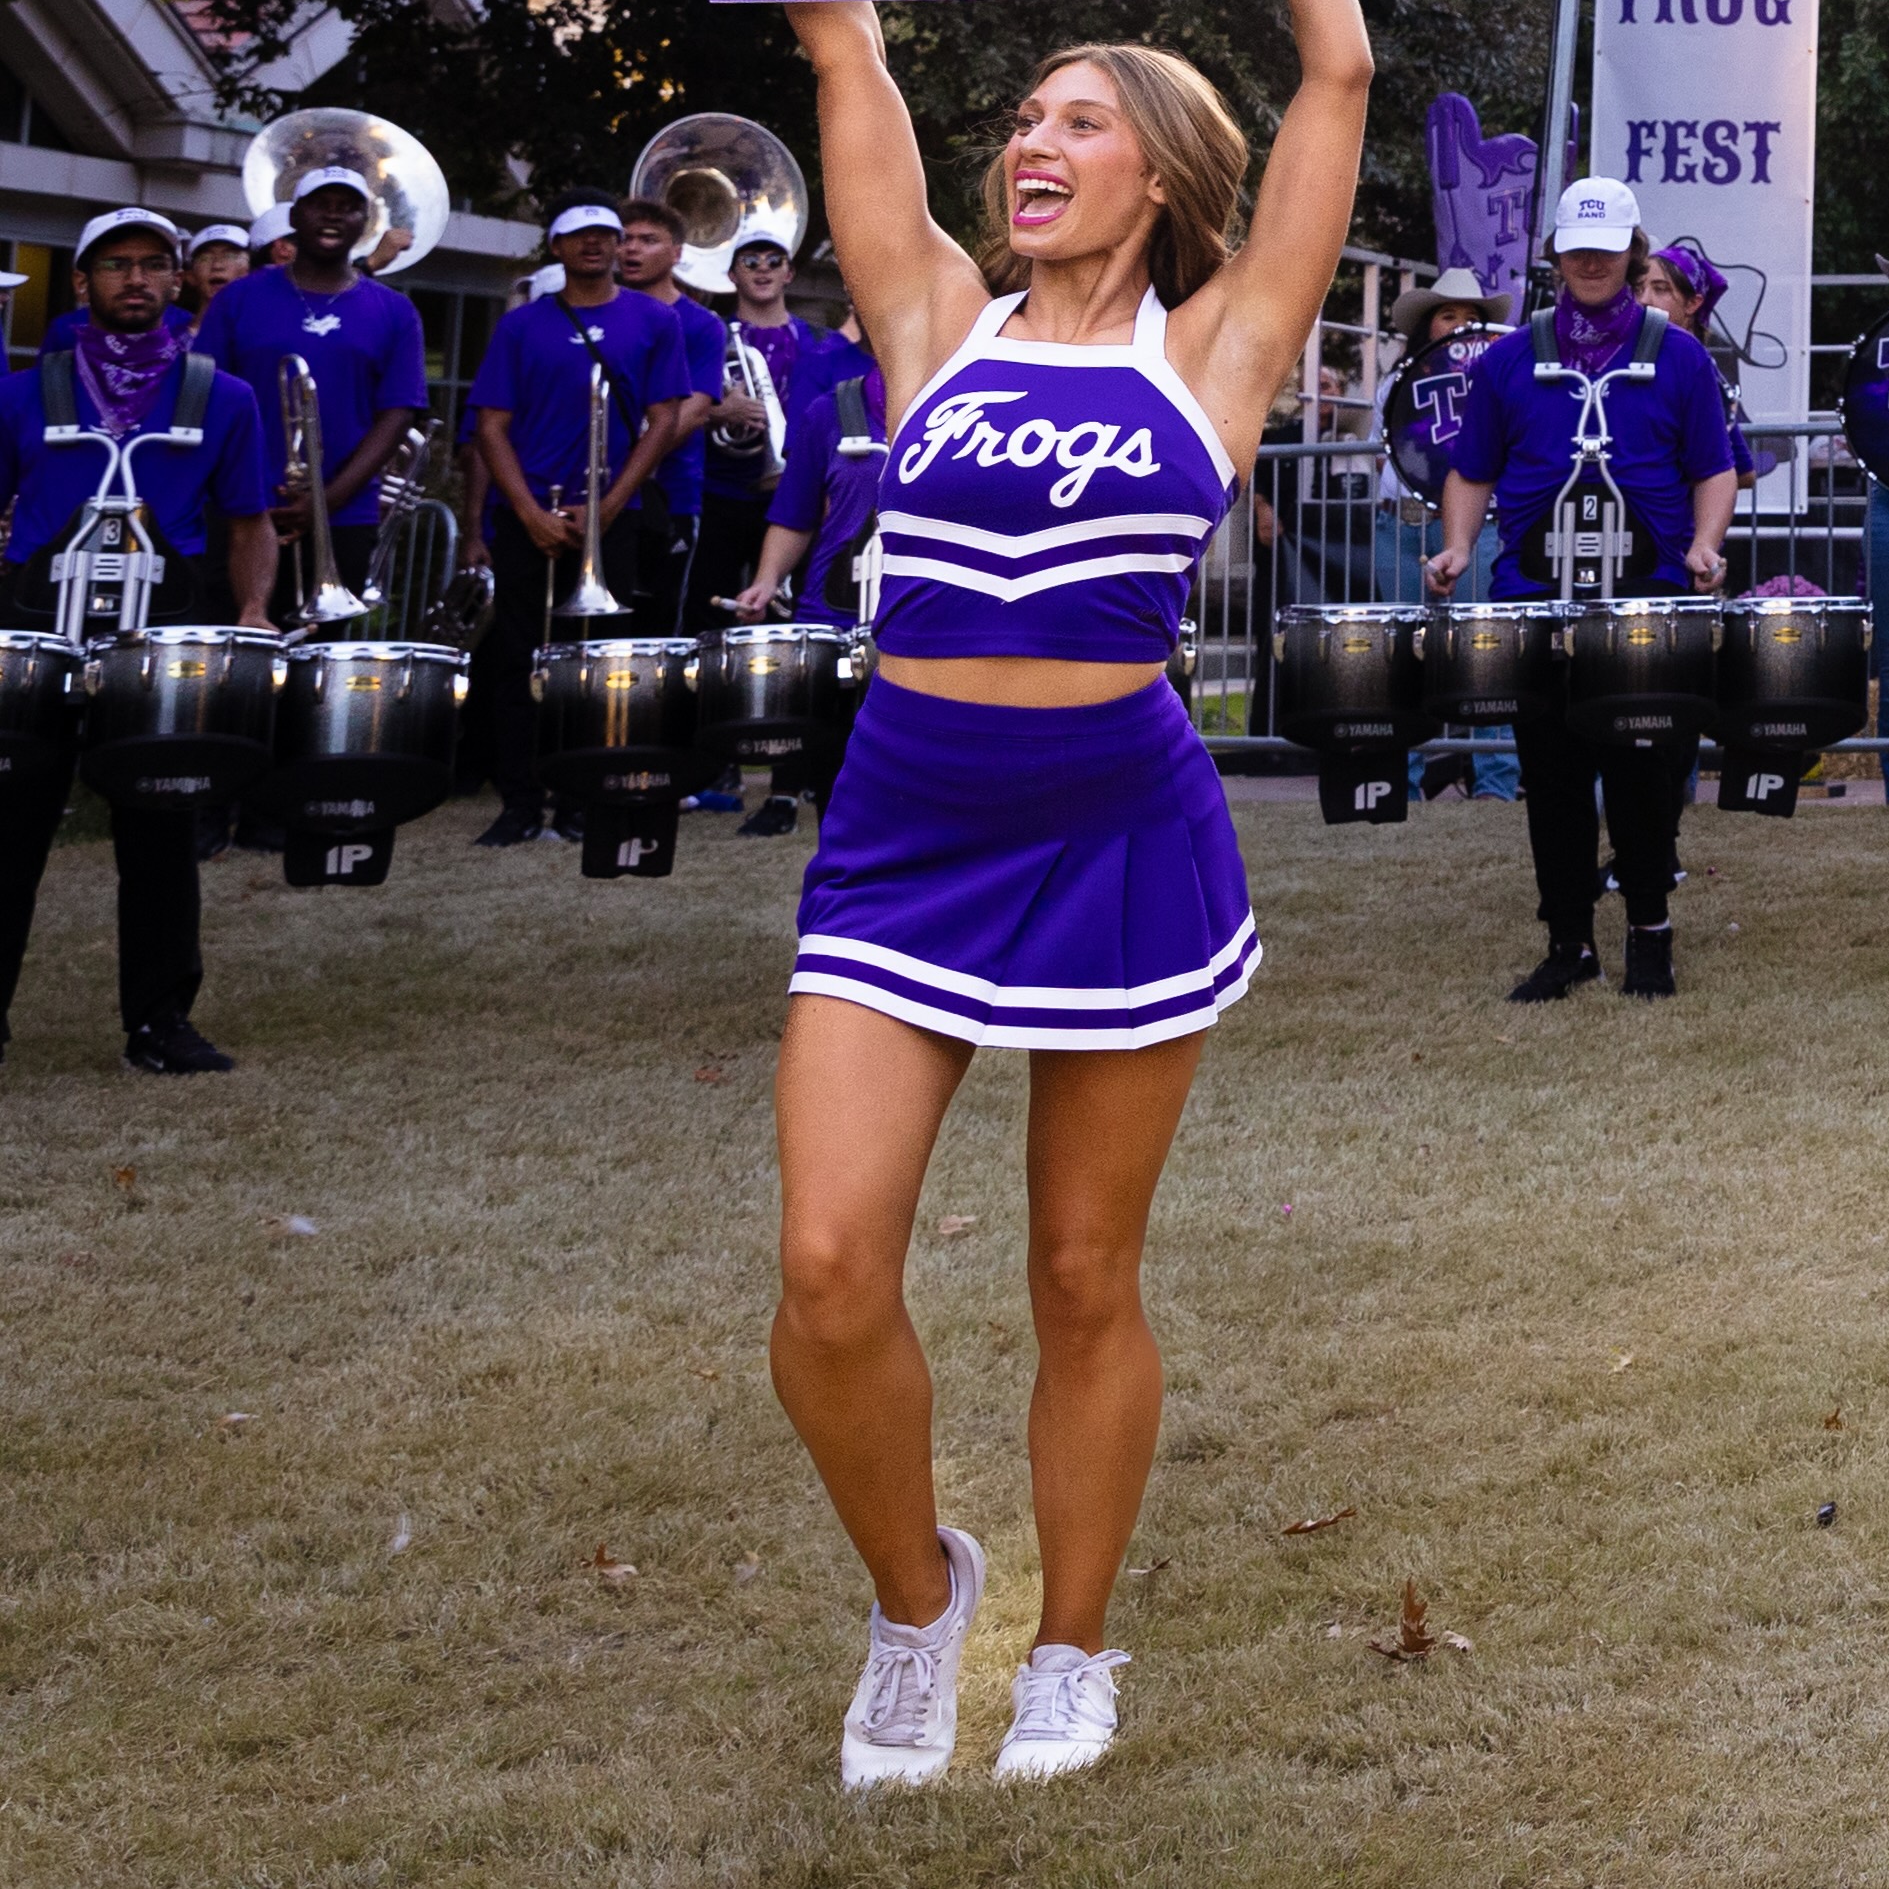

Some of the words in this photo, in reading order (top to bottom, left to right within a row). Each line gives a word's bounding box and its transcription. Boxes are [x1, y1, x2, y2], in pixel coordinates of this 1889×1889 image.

[1624, 119, 1782, 185] FEST
[1579, 198, 1605, 212] TCU
[899, 391, 1161, 508] Frogs
[1472, 699, 1518, 715] YAMAHA
[1348, 722, 1394, 737] YAMAHA
[1626, 714, 1673, 730] YAMAHA
[1763, 722, 1808, 737] YAMAHA
[753, 738, 803, 755] YAMAHA
